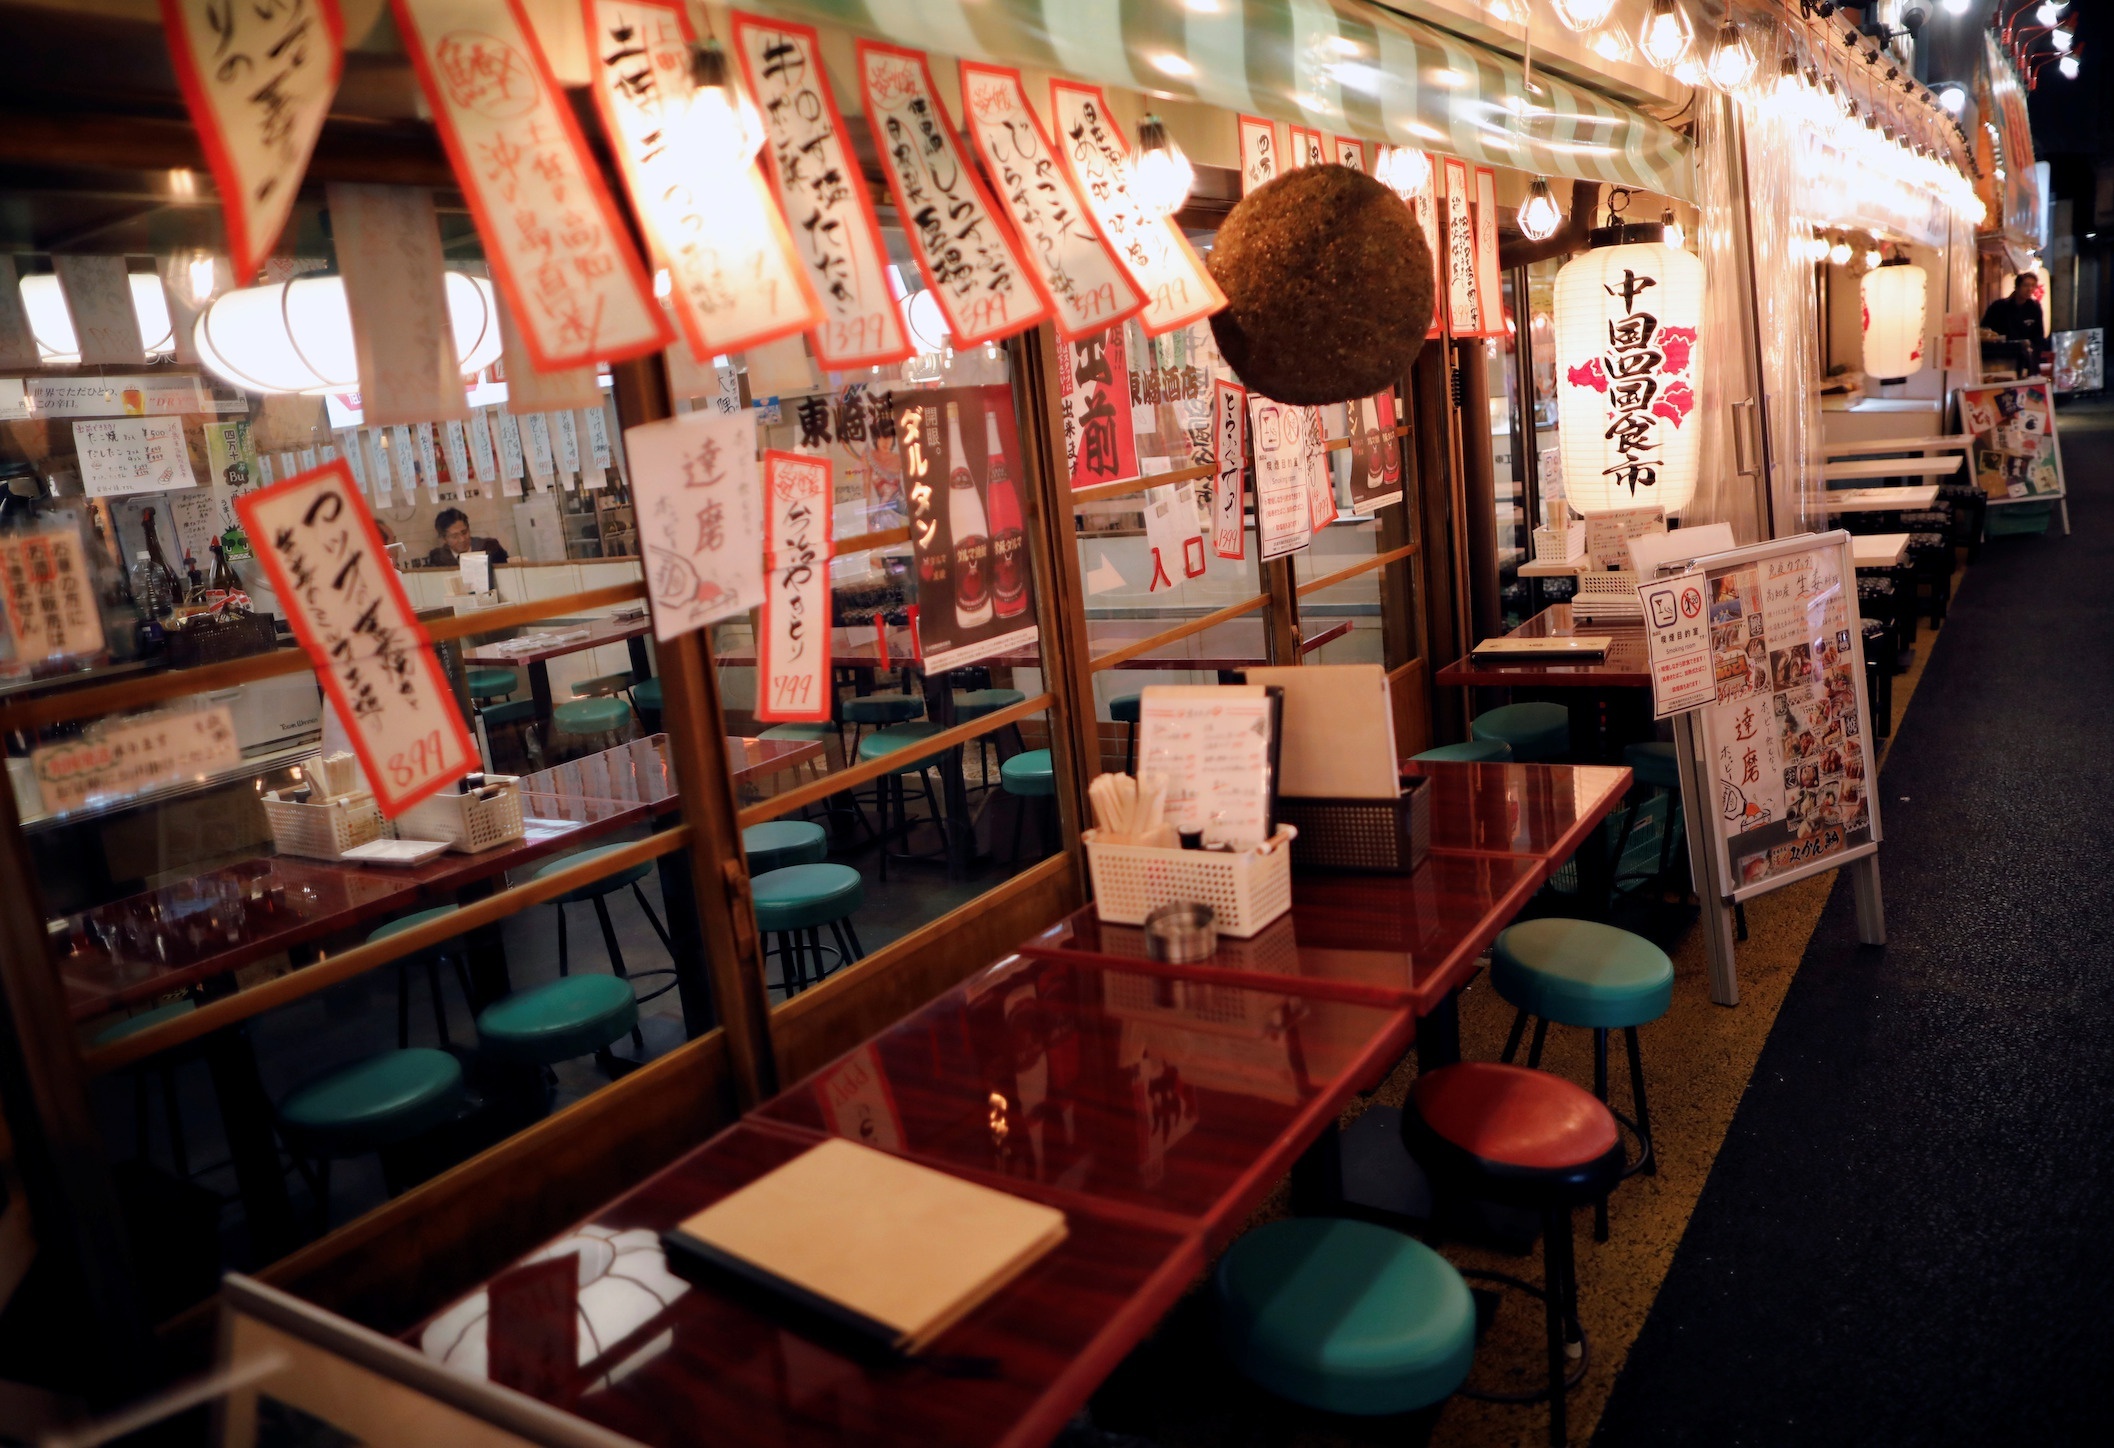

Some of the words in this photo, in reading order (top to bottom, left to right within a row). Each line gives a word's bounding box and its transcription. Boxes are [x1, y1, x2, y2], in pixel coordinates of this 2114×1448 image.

[1002, 119, 1098, 243] じゃこ天
[1075, 282, 1118, 320] 599
[822, 312, 885, 352] 1399
[1603, 268, 1664, 497] 中国四国食市
[224, 430, 238, 461] 四万十
[229, 472, 245, 482] Bu
[1150, 536, 1206, 592] 入口
[1660, 627, 1699, 644] 喫煙目的室
[1666, 645, 1684, 655] Smoking
[774, 673, 813, 709] 799
[388, 728, 446, 788] 899
[1720, 745, 1733, 780] ホッピー
[1735, 706, 1759, 786] 達磨
